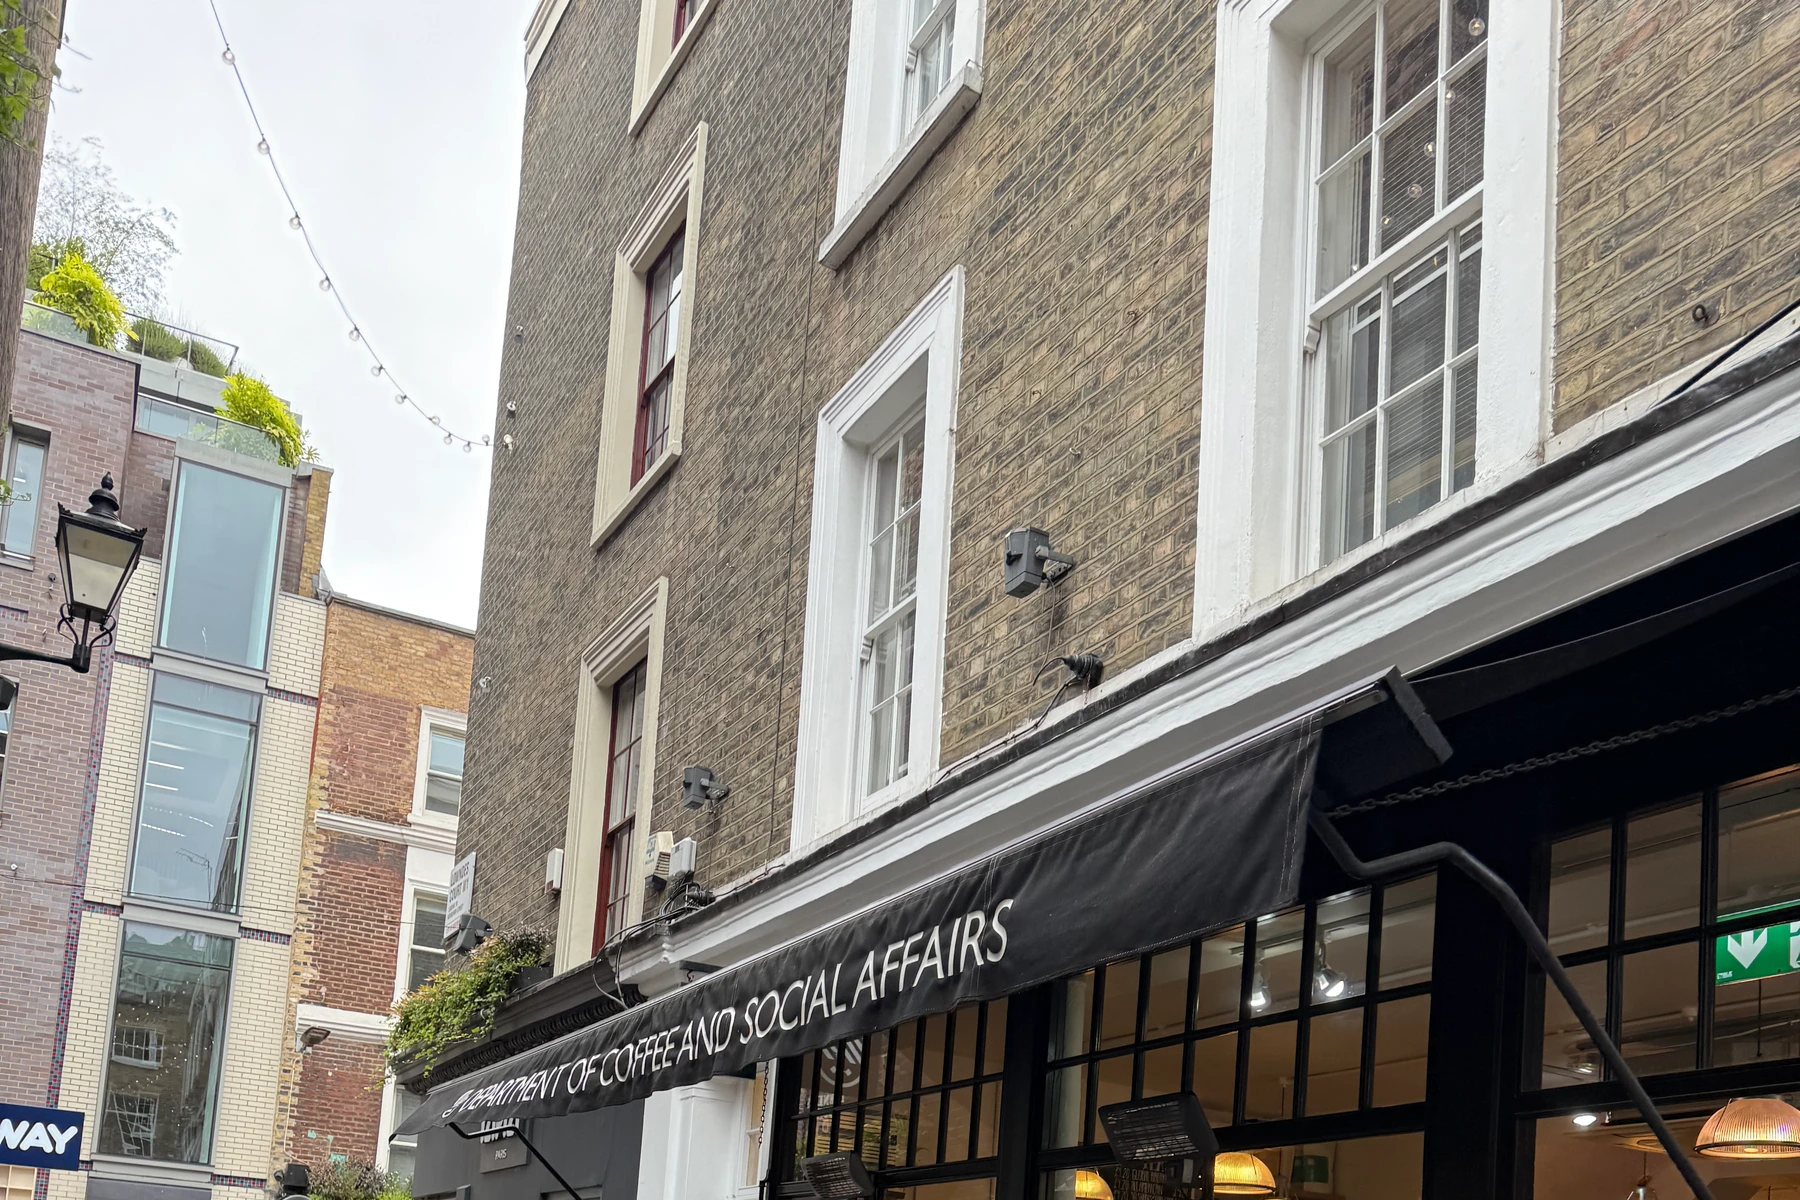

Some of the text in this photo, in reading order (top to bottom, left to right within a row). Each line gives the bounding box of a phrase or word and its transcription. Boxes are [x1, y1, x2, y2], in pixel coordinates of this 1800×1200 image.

[458, 898, 1014, 1112] DEPARTMENT OF COFFEE AND SOCIAL AFFAIRS
